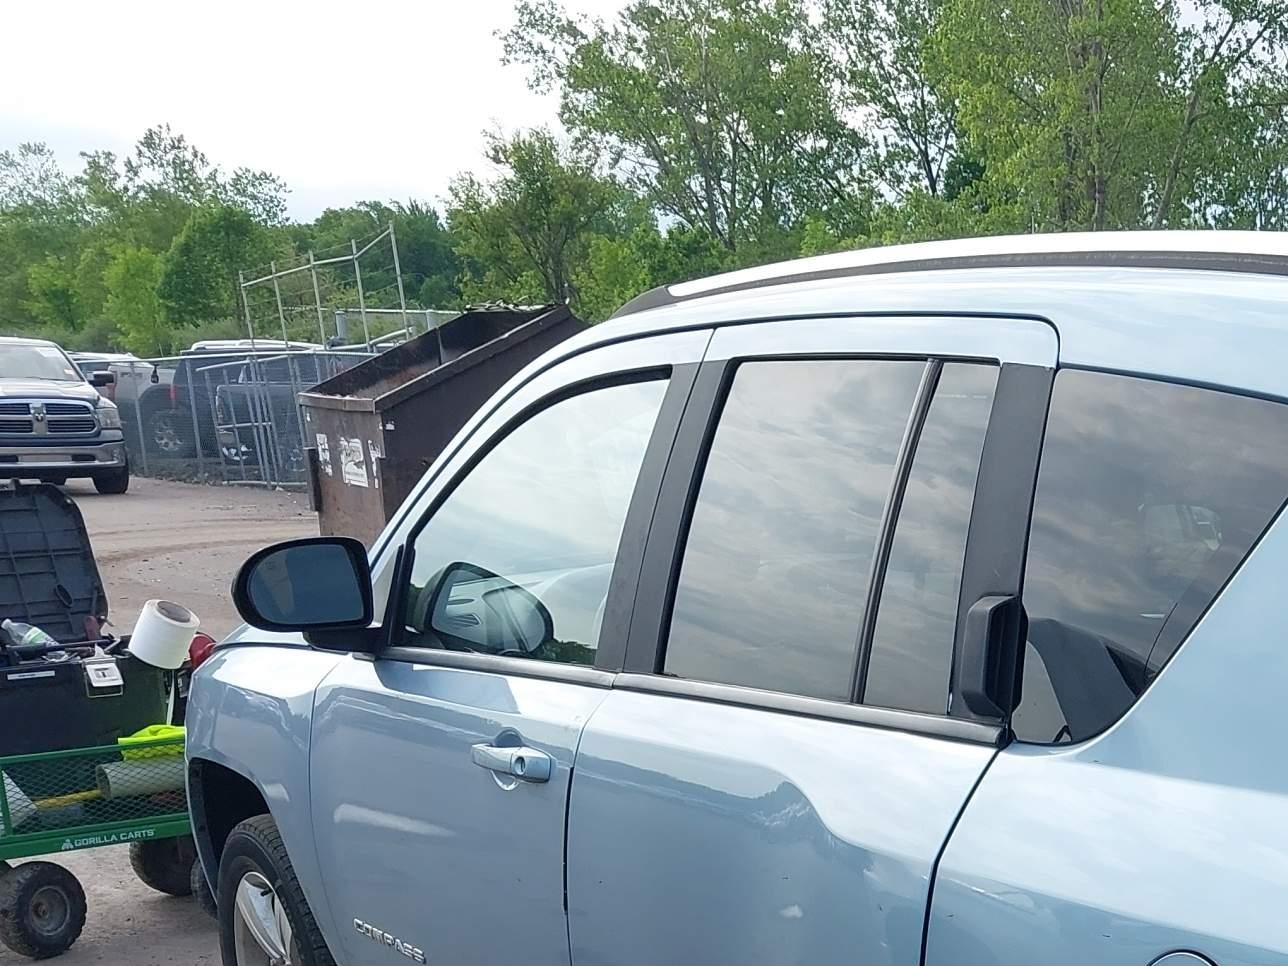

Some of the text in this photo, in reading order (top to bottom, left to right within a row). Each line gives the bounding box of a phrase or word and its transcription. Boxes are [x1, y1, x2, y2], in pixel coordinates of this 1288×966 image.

[74, 829, 155, 847] GORILLA CARTS
[352, 917, 426, 964] COMPASS
